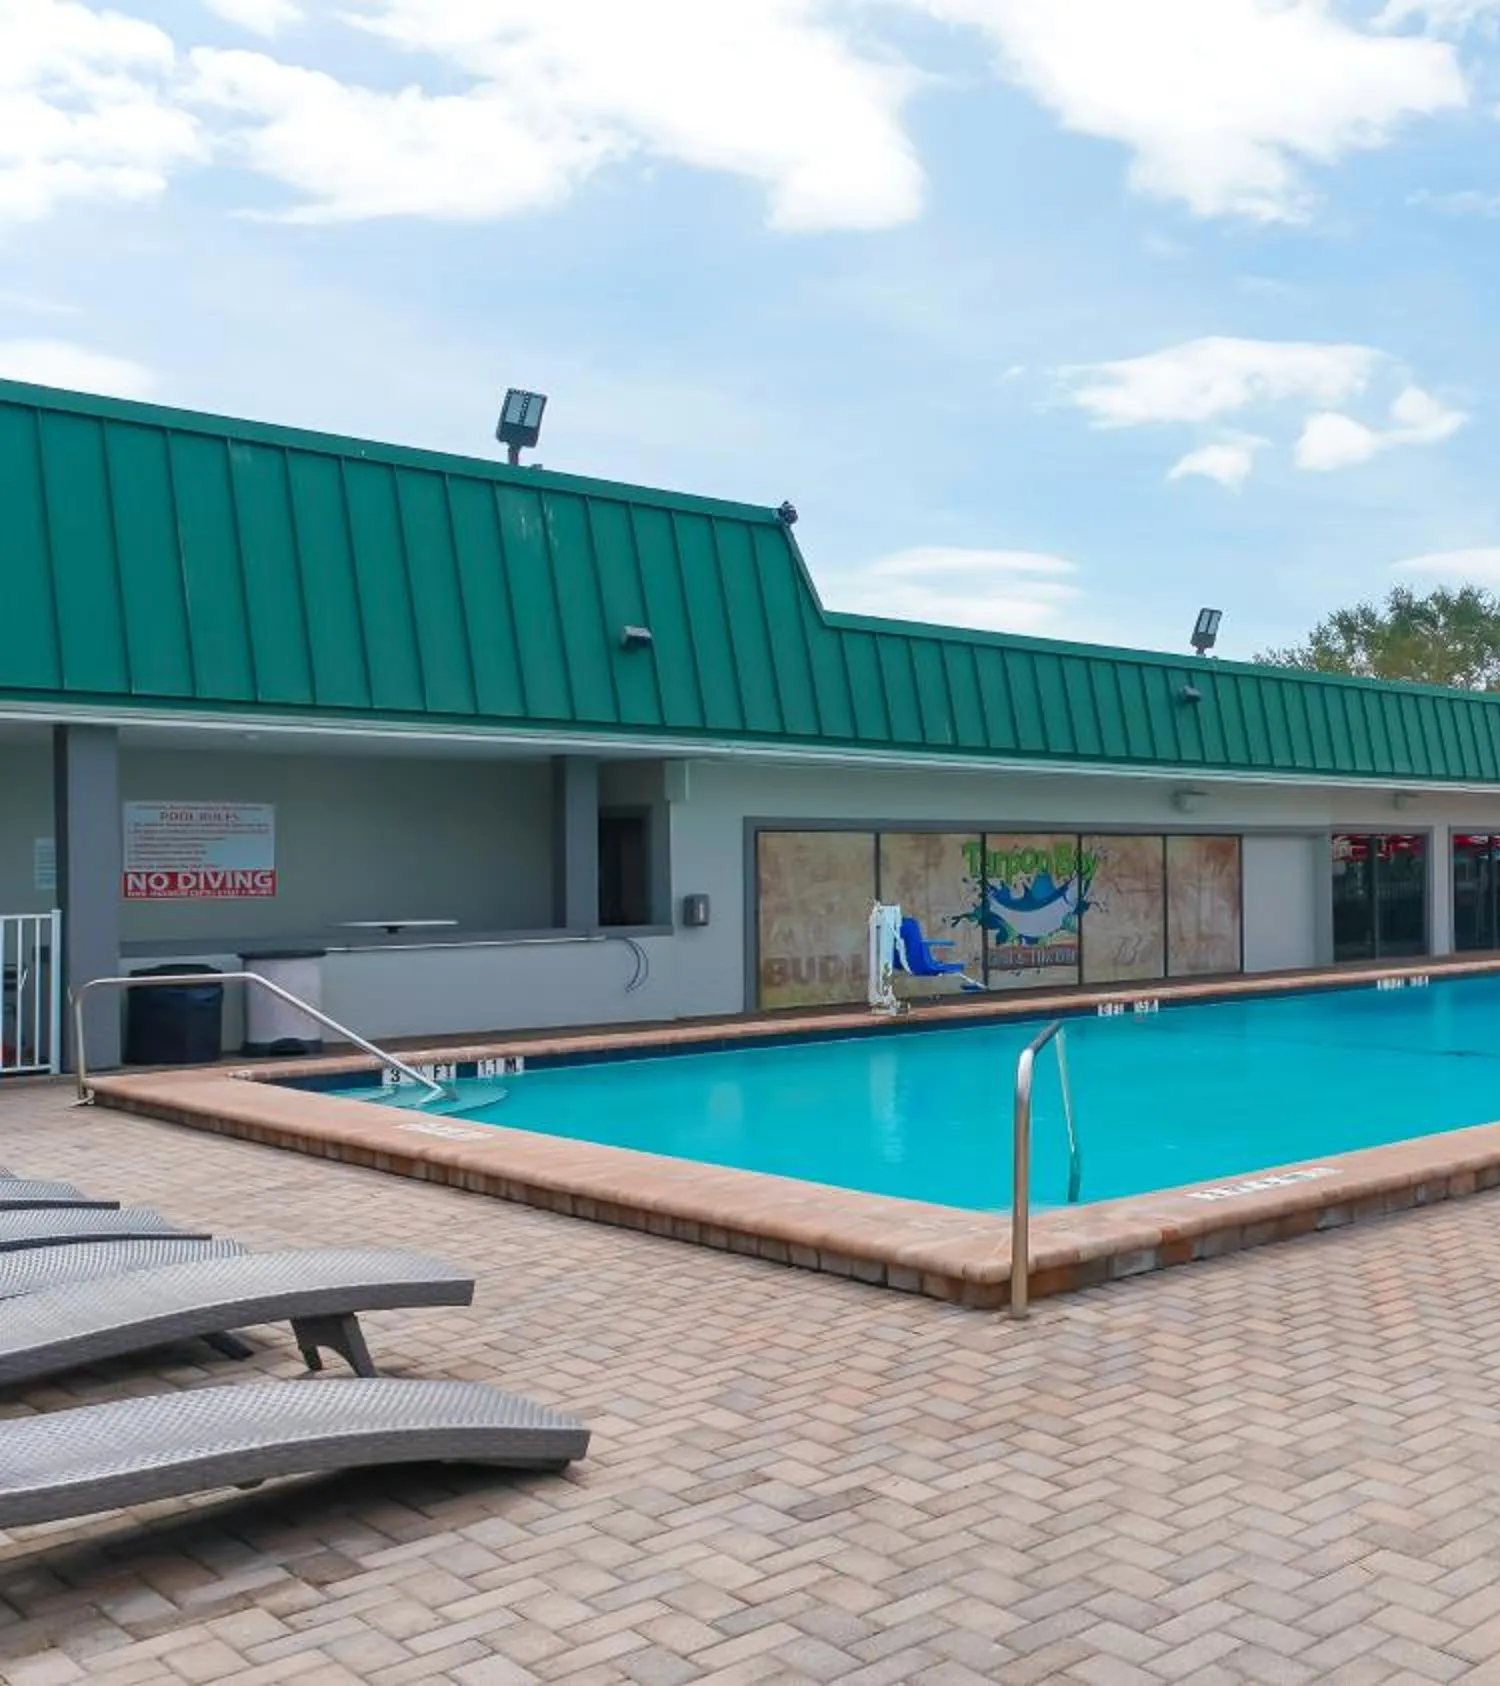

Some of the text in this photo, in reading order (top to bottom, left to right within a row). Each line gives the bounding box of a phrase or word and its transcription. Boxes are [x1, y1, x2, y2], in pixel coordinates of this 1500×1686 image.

[128, 871, 273, 890] NO DIVING
[391, 1068, 400, 1082] 3
[433, 1063, 453, 1081] FT
[504, 1057, 517, 1073] M
